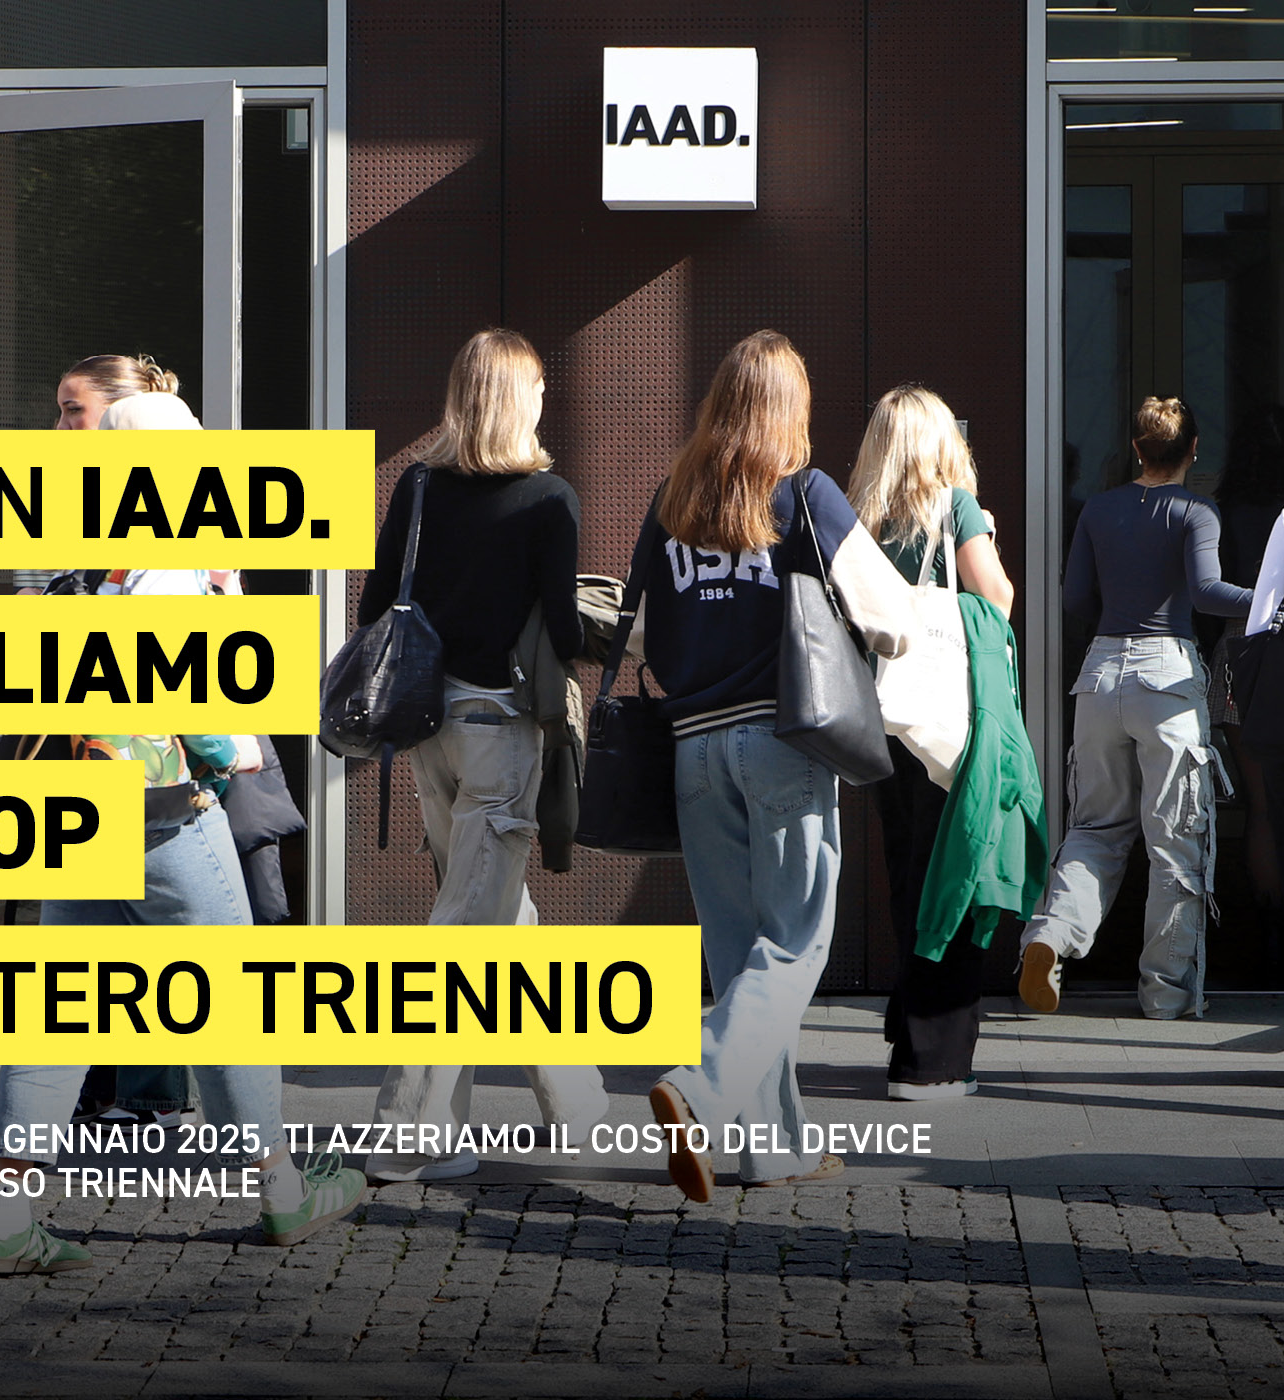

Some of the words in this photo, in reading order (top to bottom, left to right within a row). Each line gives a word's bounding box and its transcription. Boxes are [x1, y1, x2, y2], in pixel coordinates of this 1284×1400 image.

[606, 103, 750, 147] IAAD.
[664, 536, 780, 593] USA
[699, 587, 735, 600] 1984
